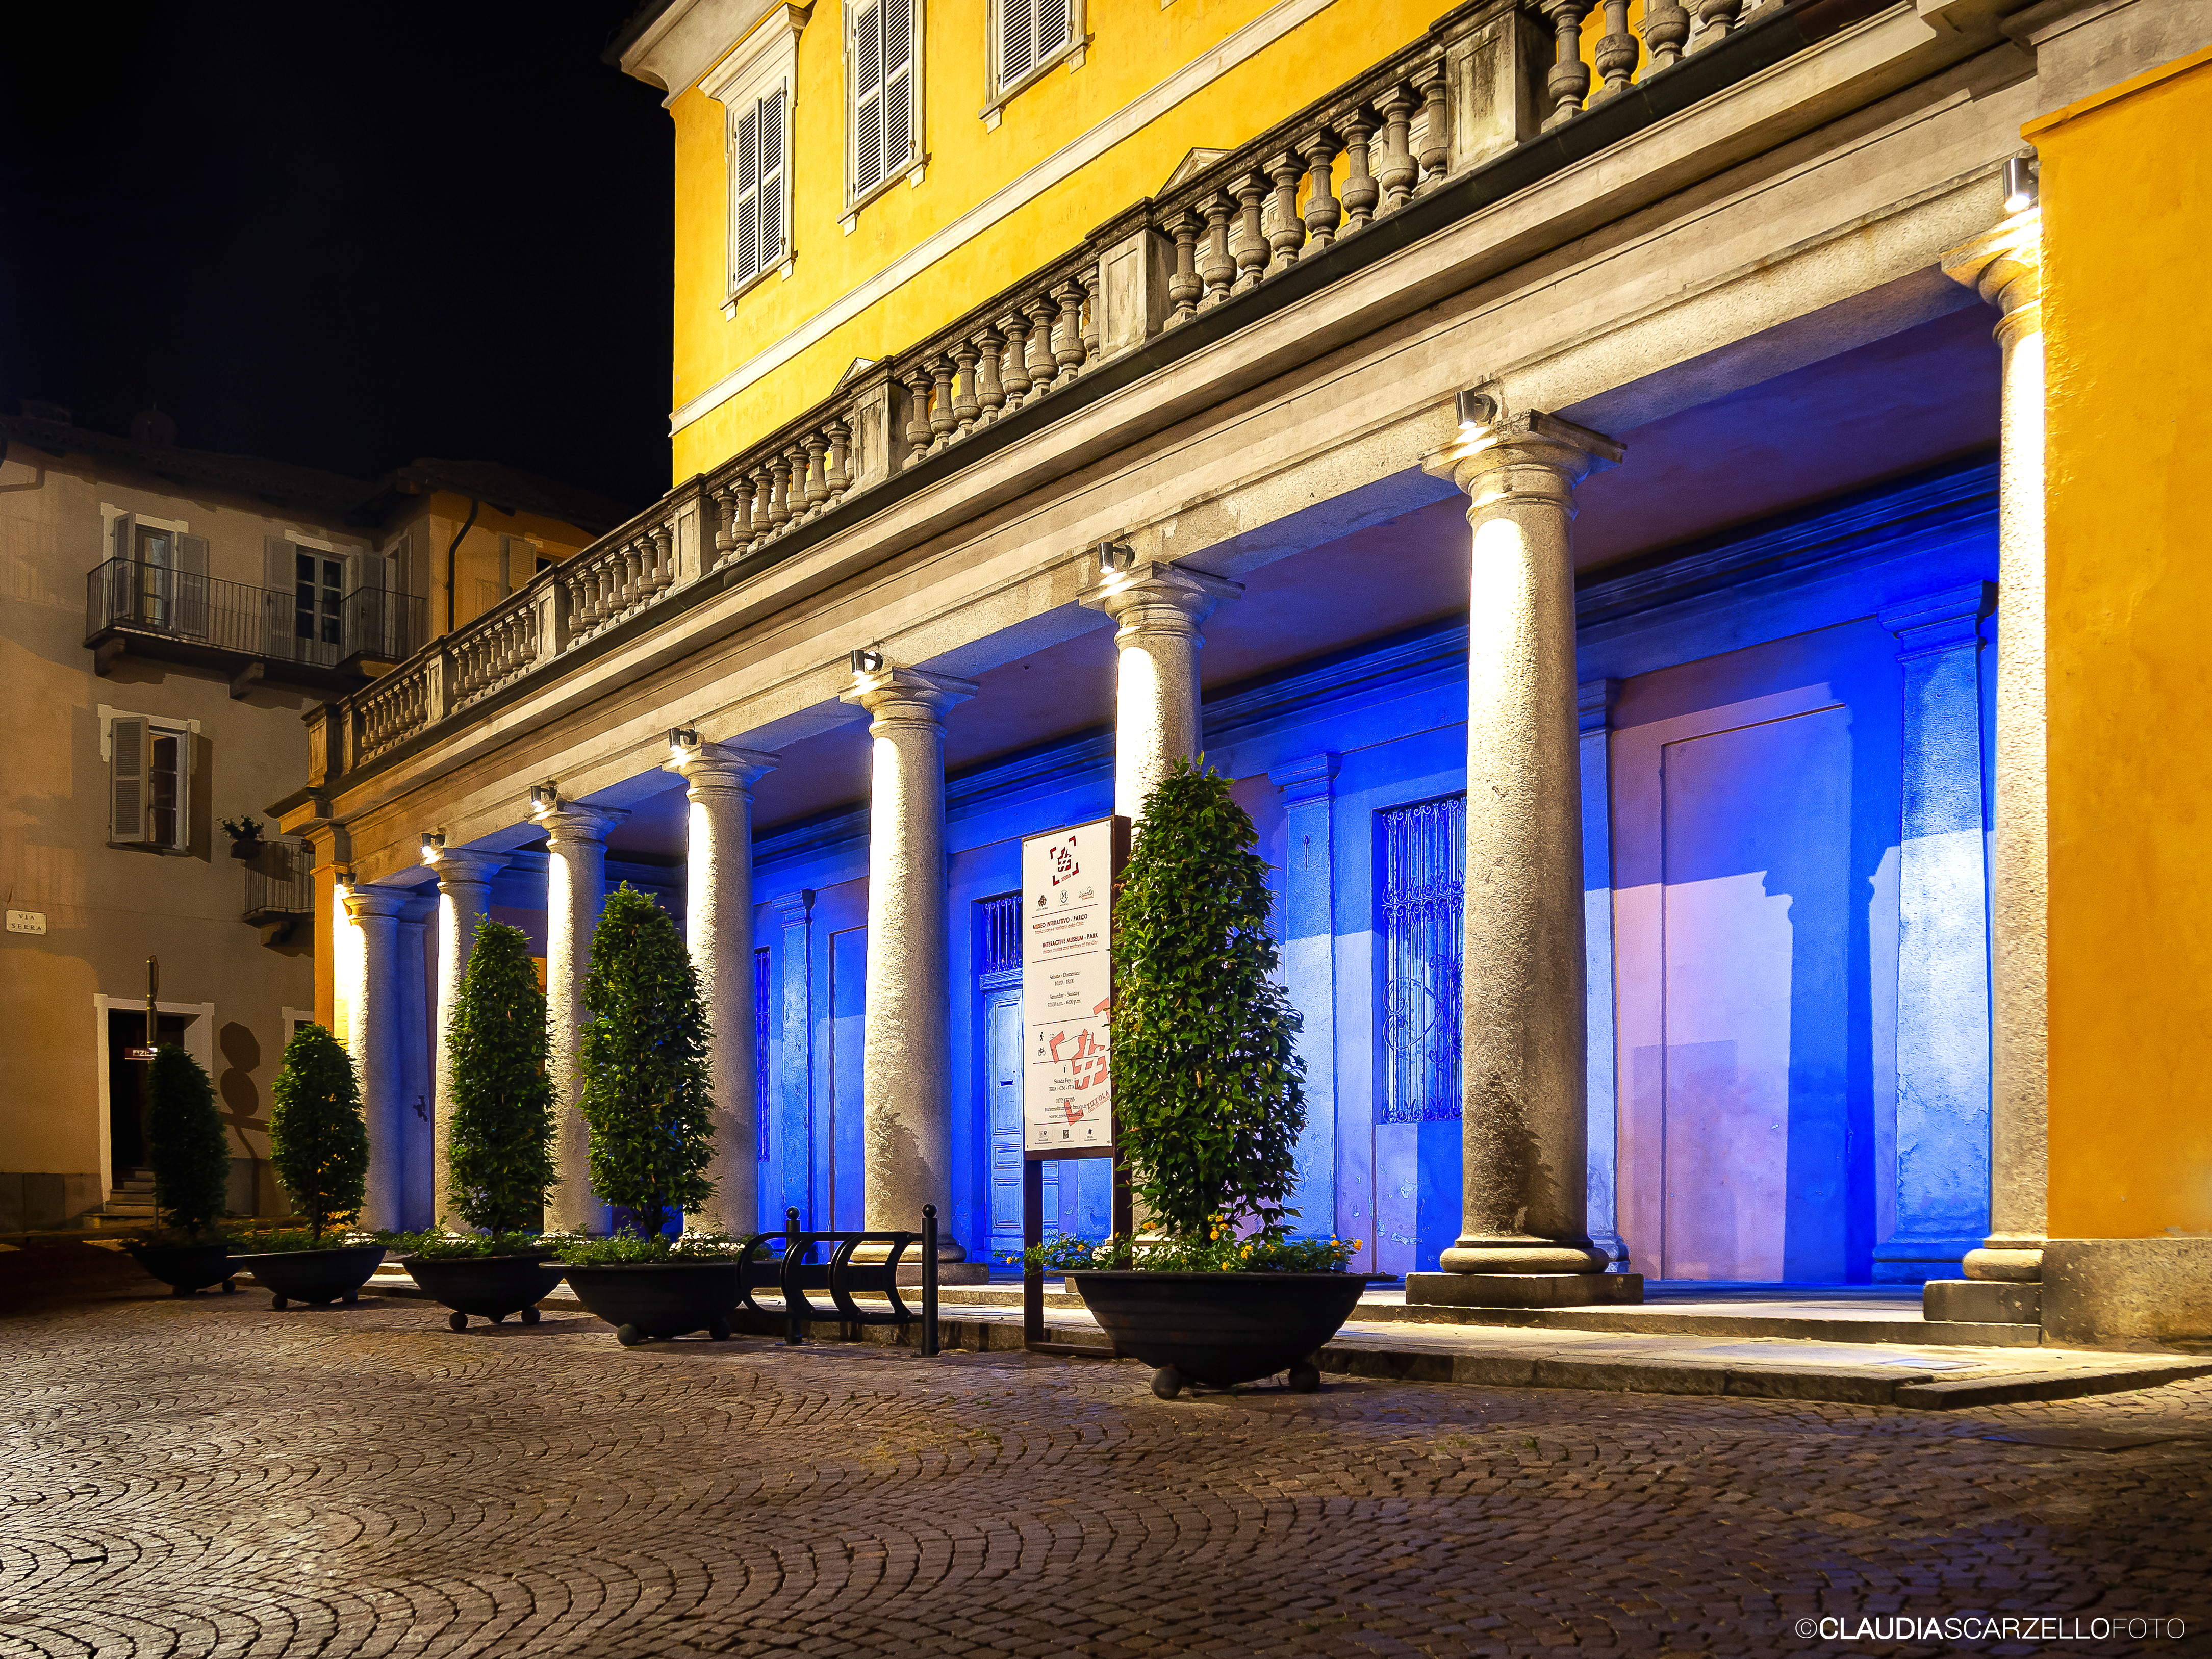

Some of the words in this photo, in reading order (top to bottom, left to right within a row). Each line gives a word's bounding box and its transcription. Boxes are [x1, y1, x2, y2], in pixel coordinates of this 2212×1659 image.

[1047, 917, 1070, 927] INTERATTIVO
[1043, 938, 1065, 948] INTERACTIVE
[1087, 1090, 1110, 1110] ZIZZOLA
